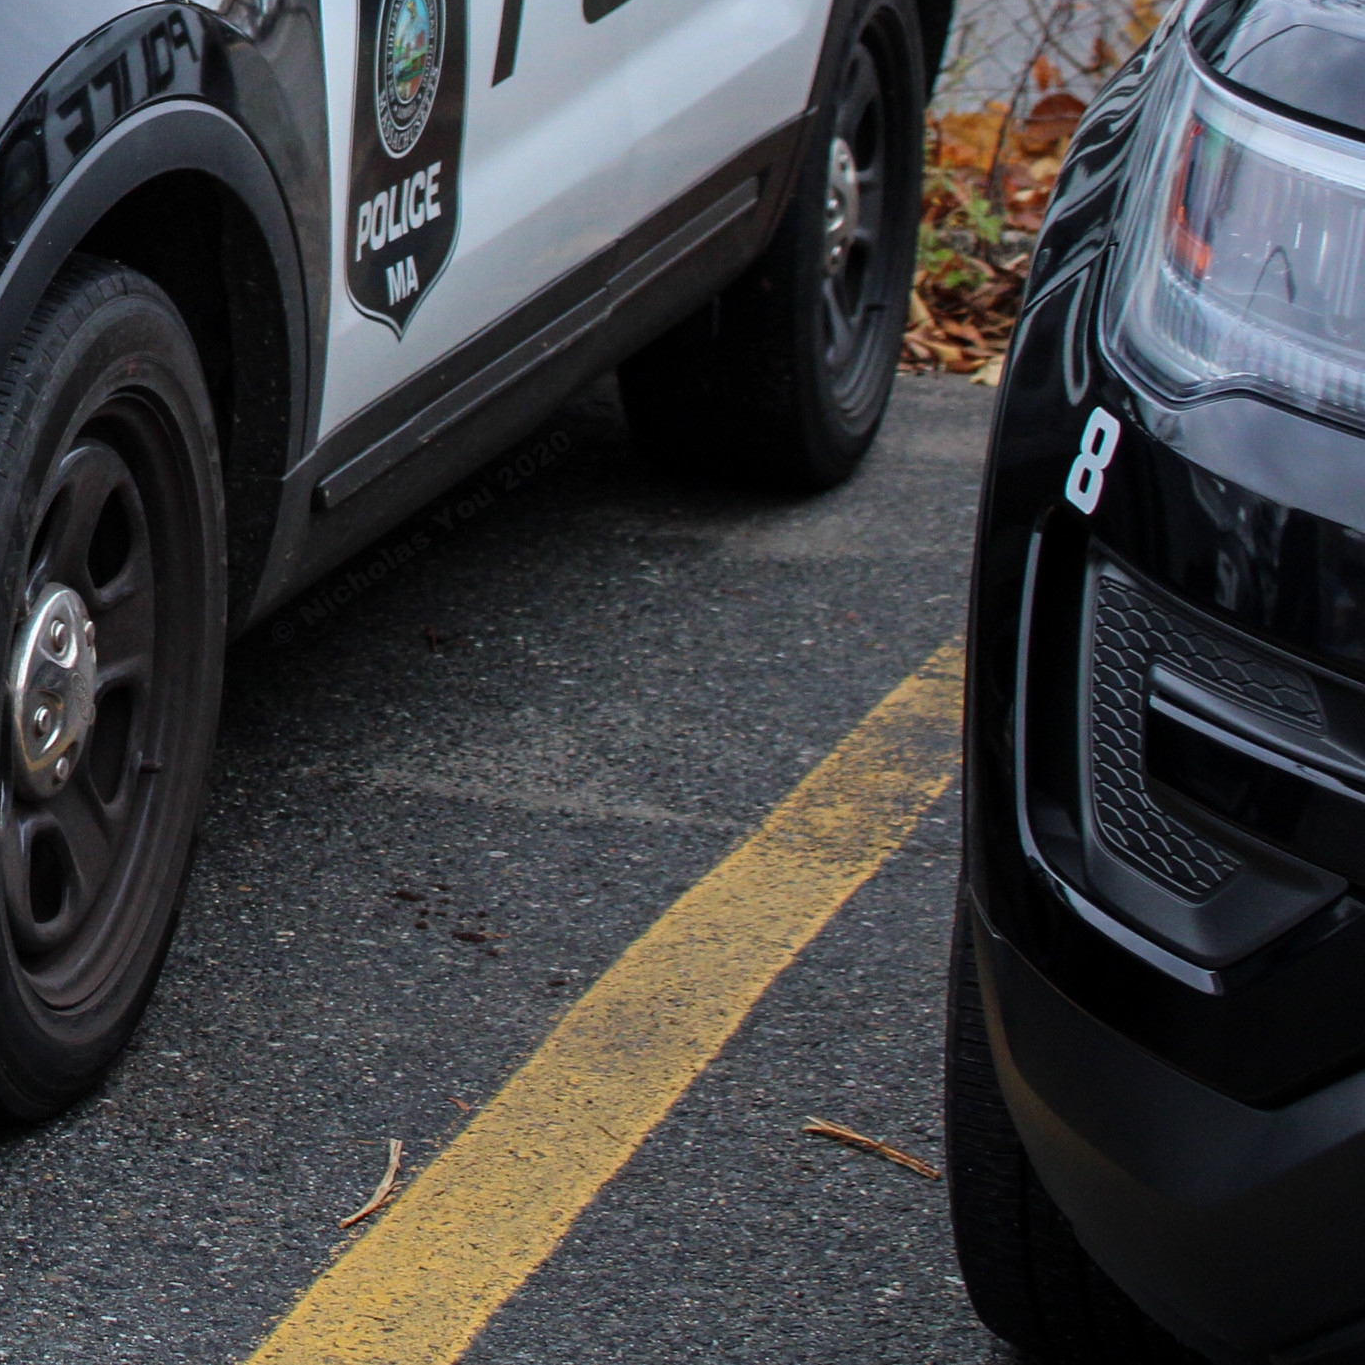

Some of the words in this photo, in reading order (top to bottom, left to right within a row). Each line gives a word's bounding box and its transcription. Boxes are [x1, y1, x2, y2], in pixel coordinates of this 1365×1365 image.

[355, 161, 442, 263] POLICE
[385, 255, 419, 307] MA
[1065, 406, 1121, 515] 8
